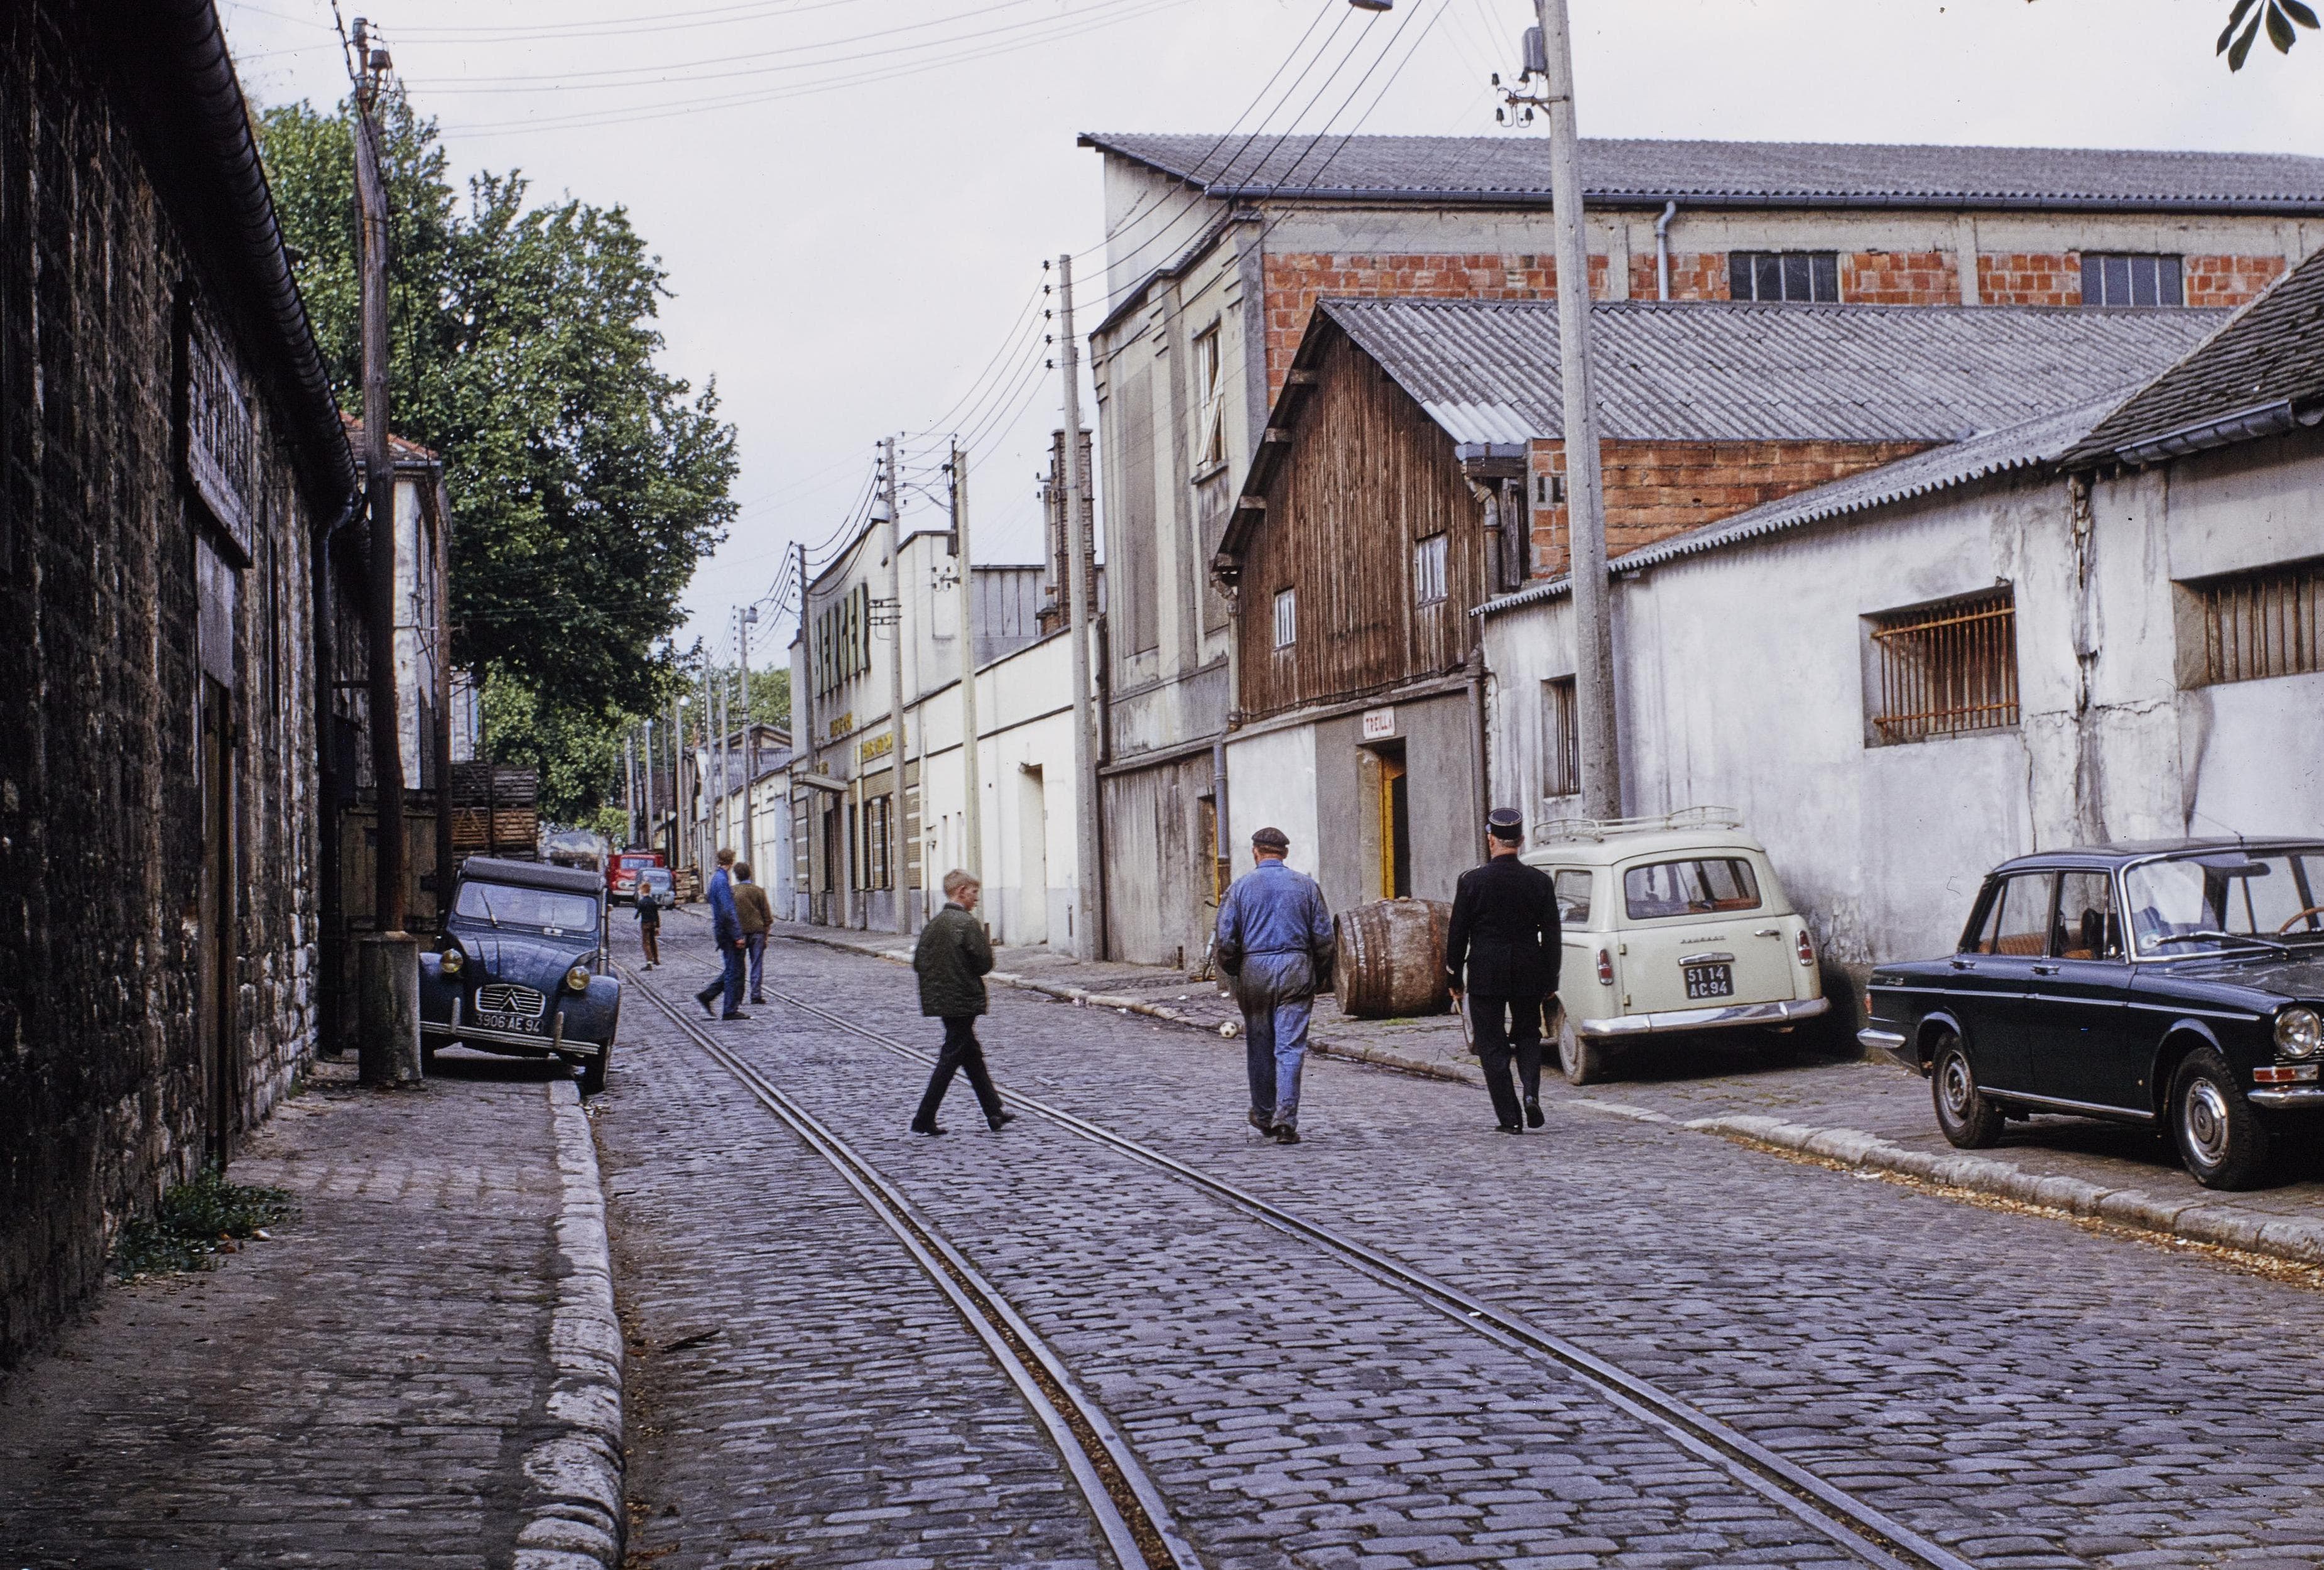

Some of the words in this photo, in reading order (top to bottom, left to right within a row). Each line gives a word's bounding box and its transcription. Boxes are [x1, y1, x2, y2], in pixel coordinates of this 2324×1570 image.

[810, 583, 868, 698] BERGER
[1690, 983, 1708, 997] AC
[1710, 981, 1727, 995] 94
[475, 1013, 506, 1028] 3906
[508, 1017, 523, 1031] AE
[525, 1020, 540, 1033] 94
